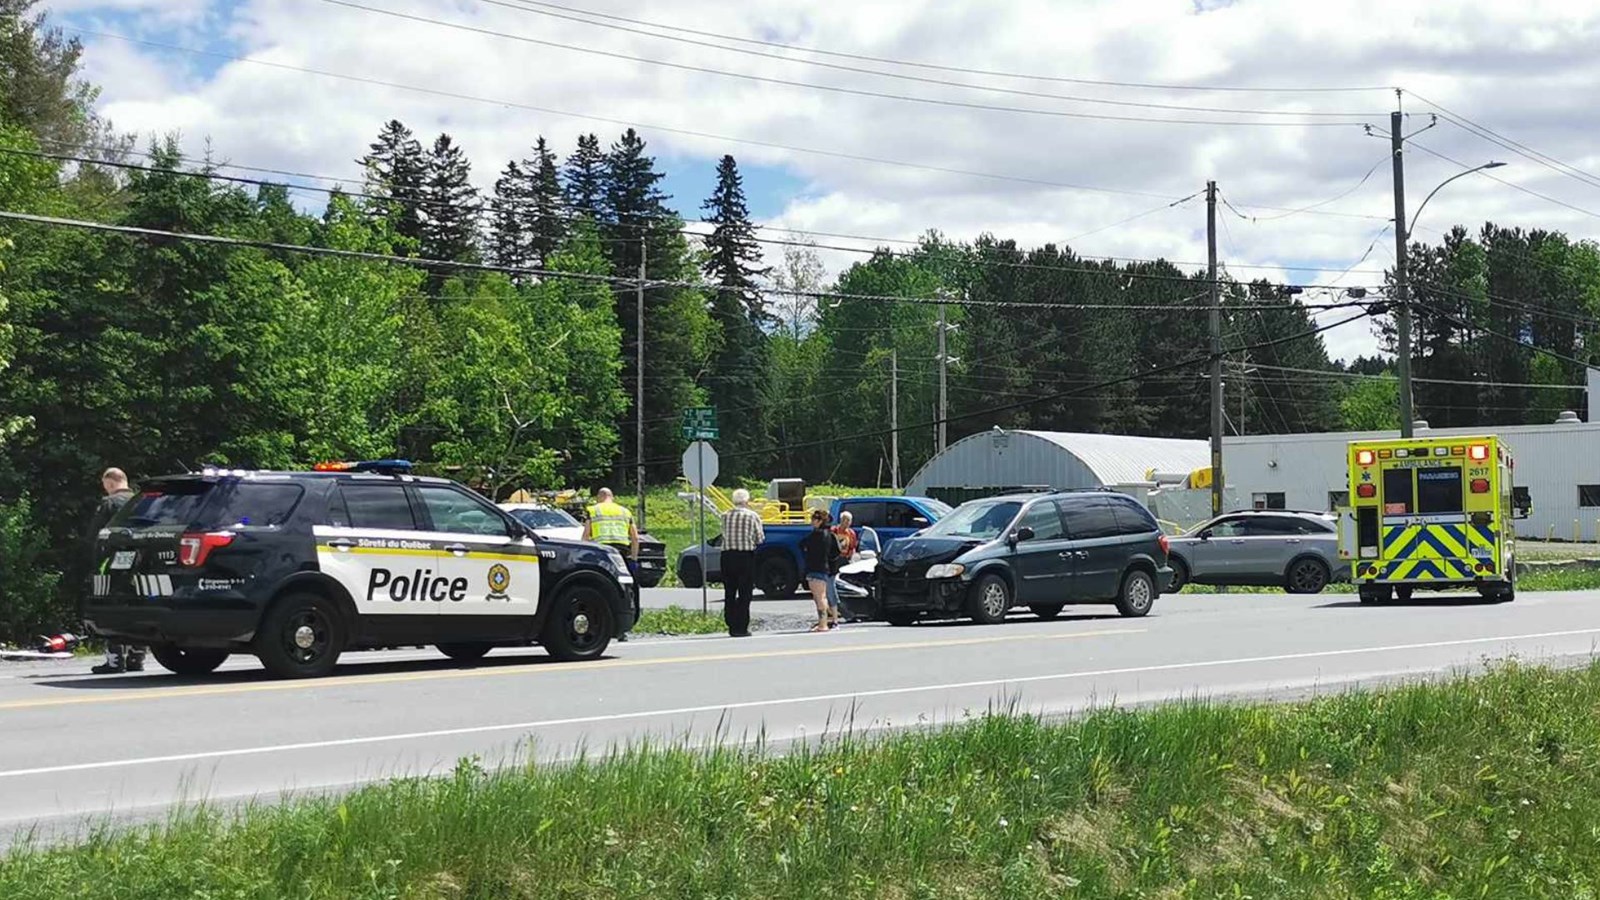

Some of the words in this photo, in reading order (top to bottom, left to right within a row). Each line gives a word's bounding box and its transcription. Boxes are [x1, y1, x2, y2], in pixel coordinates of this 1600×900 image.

[1398, 459, 1441, 469] AMBULANCE
[1469, 468, 1488, 476] 2617
[358, 538, 386, 548] Sûreté
[388, 540, 399, 548] du
[400, 540, 431, 549] Québec
[158, 551, 175, 559] 1113
[541, 550, 556, 559] 1113
[367, 568, 468, 602] Police
